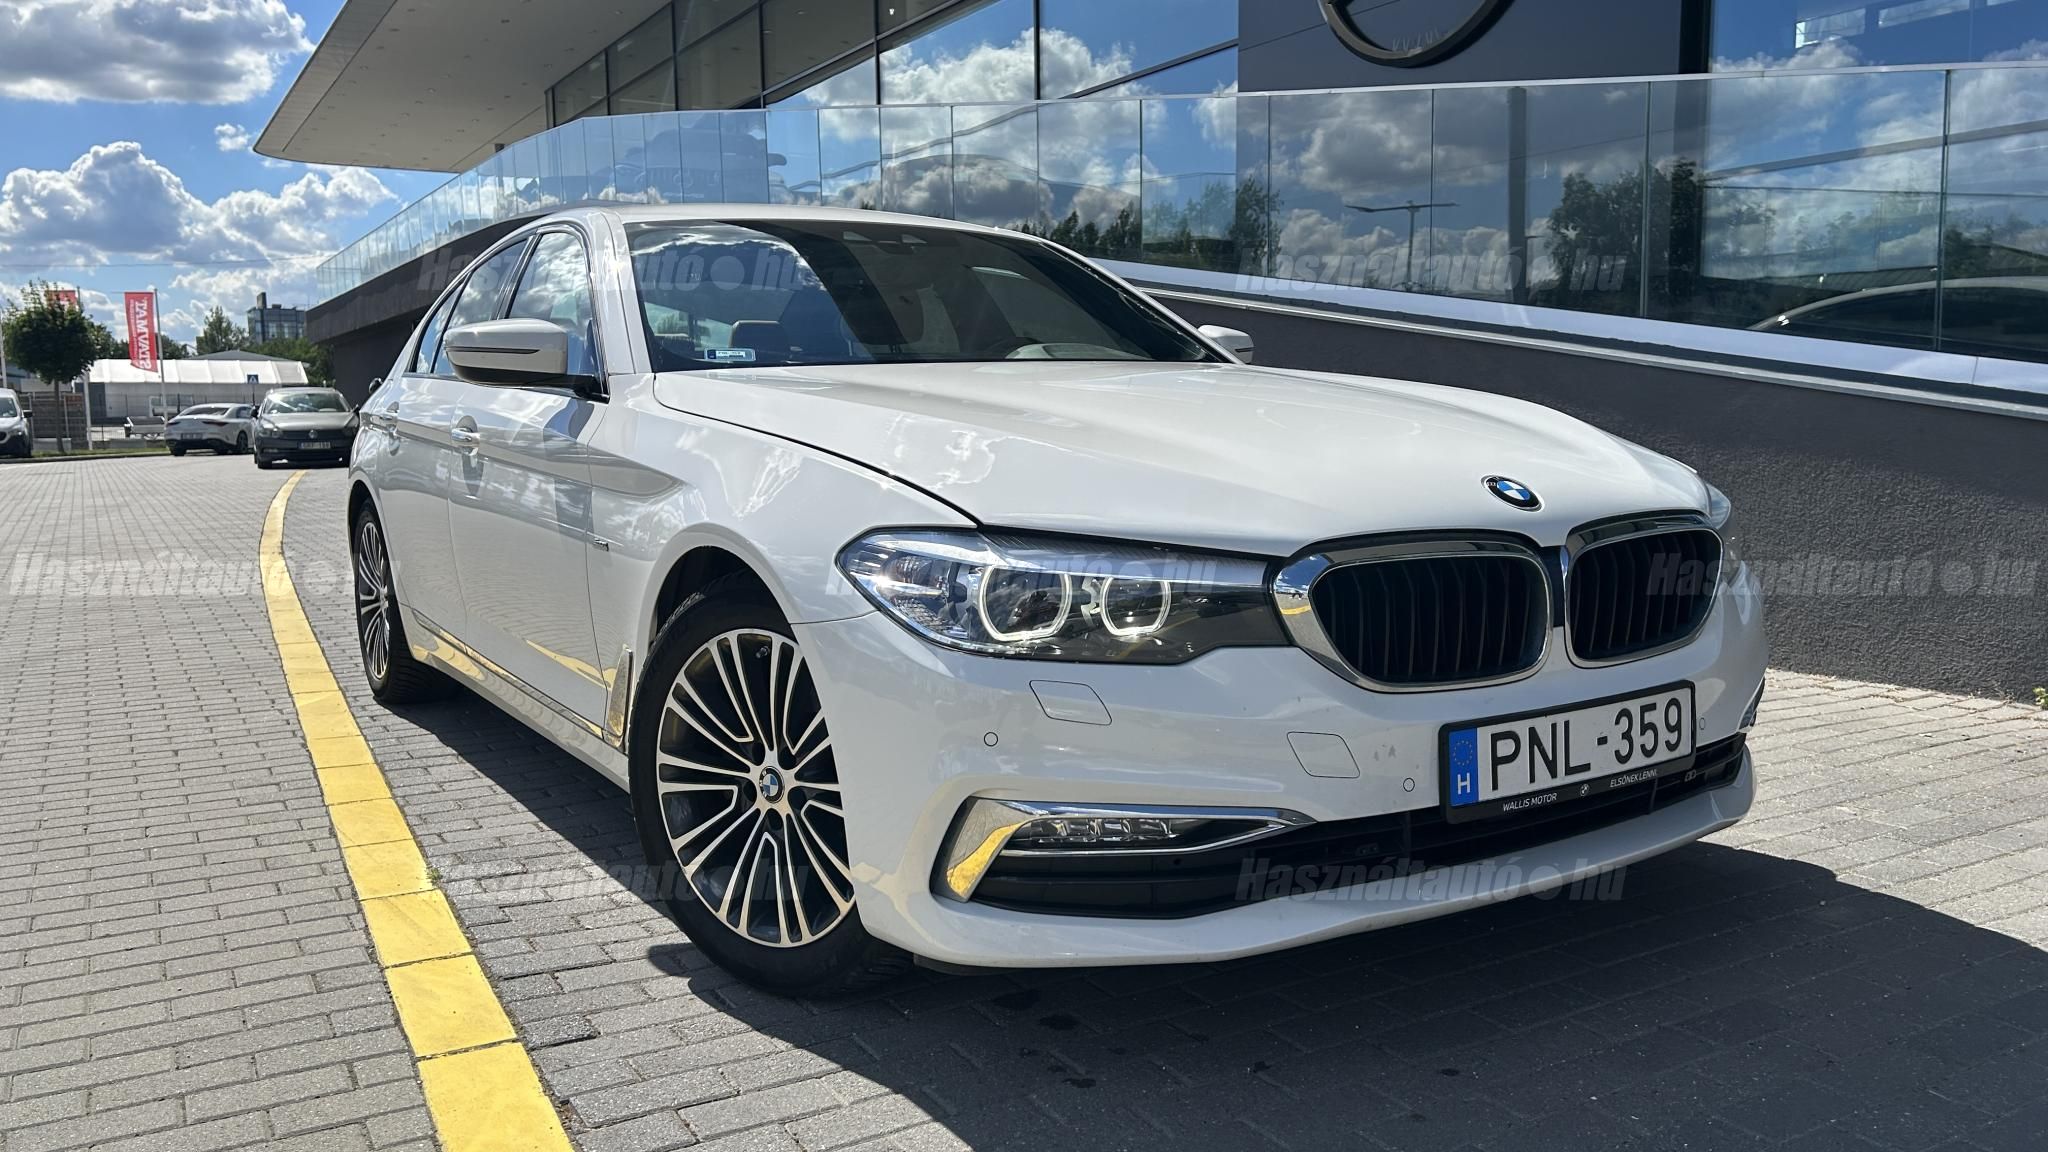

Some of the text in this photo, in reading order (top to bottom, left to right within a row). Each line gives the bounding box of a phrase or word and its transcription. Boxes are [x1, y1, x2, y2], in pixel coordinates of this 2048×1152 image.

[1489, 697, 1683, 792] PNL-359
[1457, 772, 1471, 795] H
[1502, 792, 1558, 811] WALLIS MOTOR
